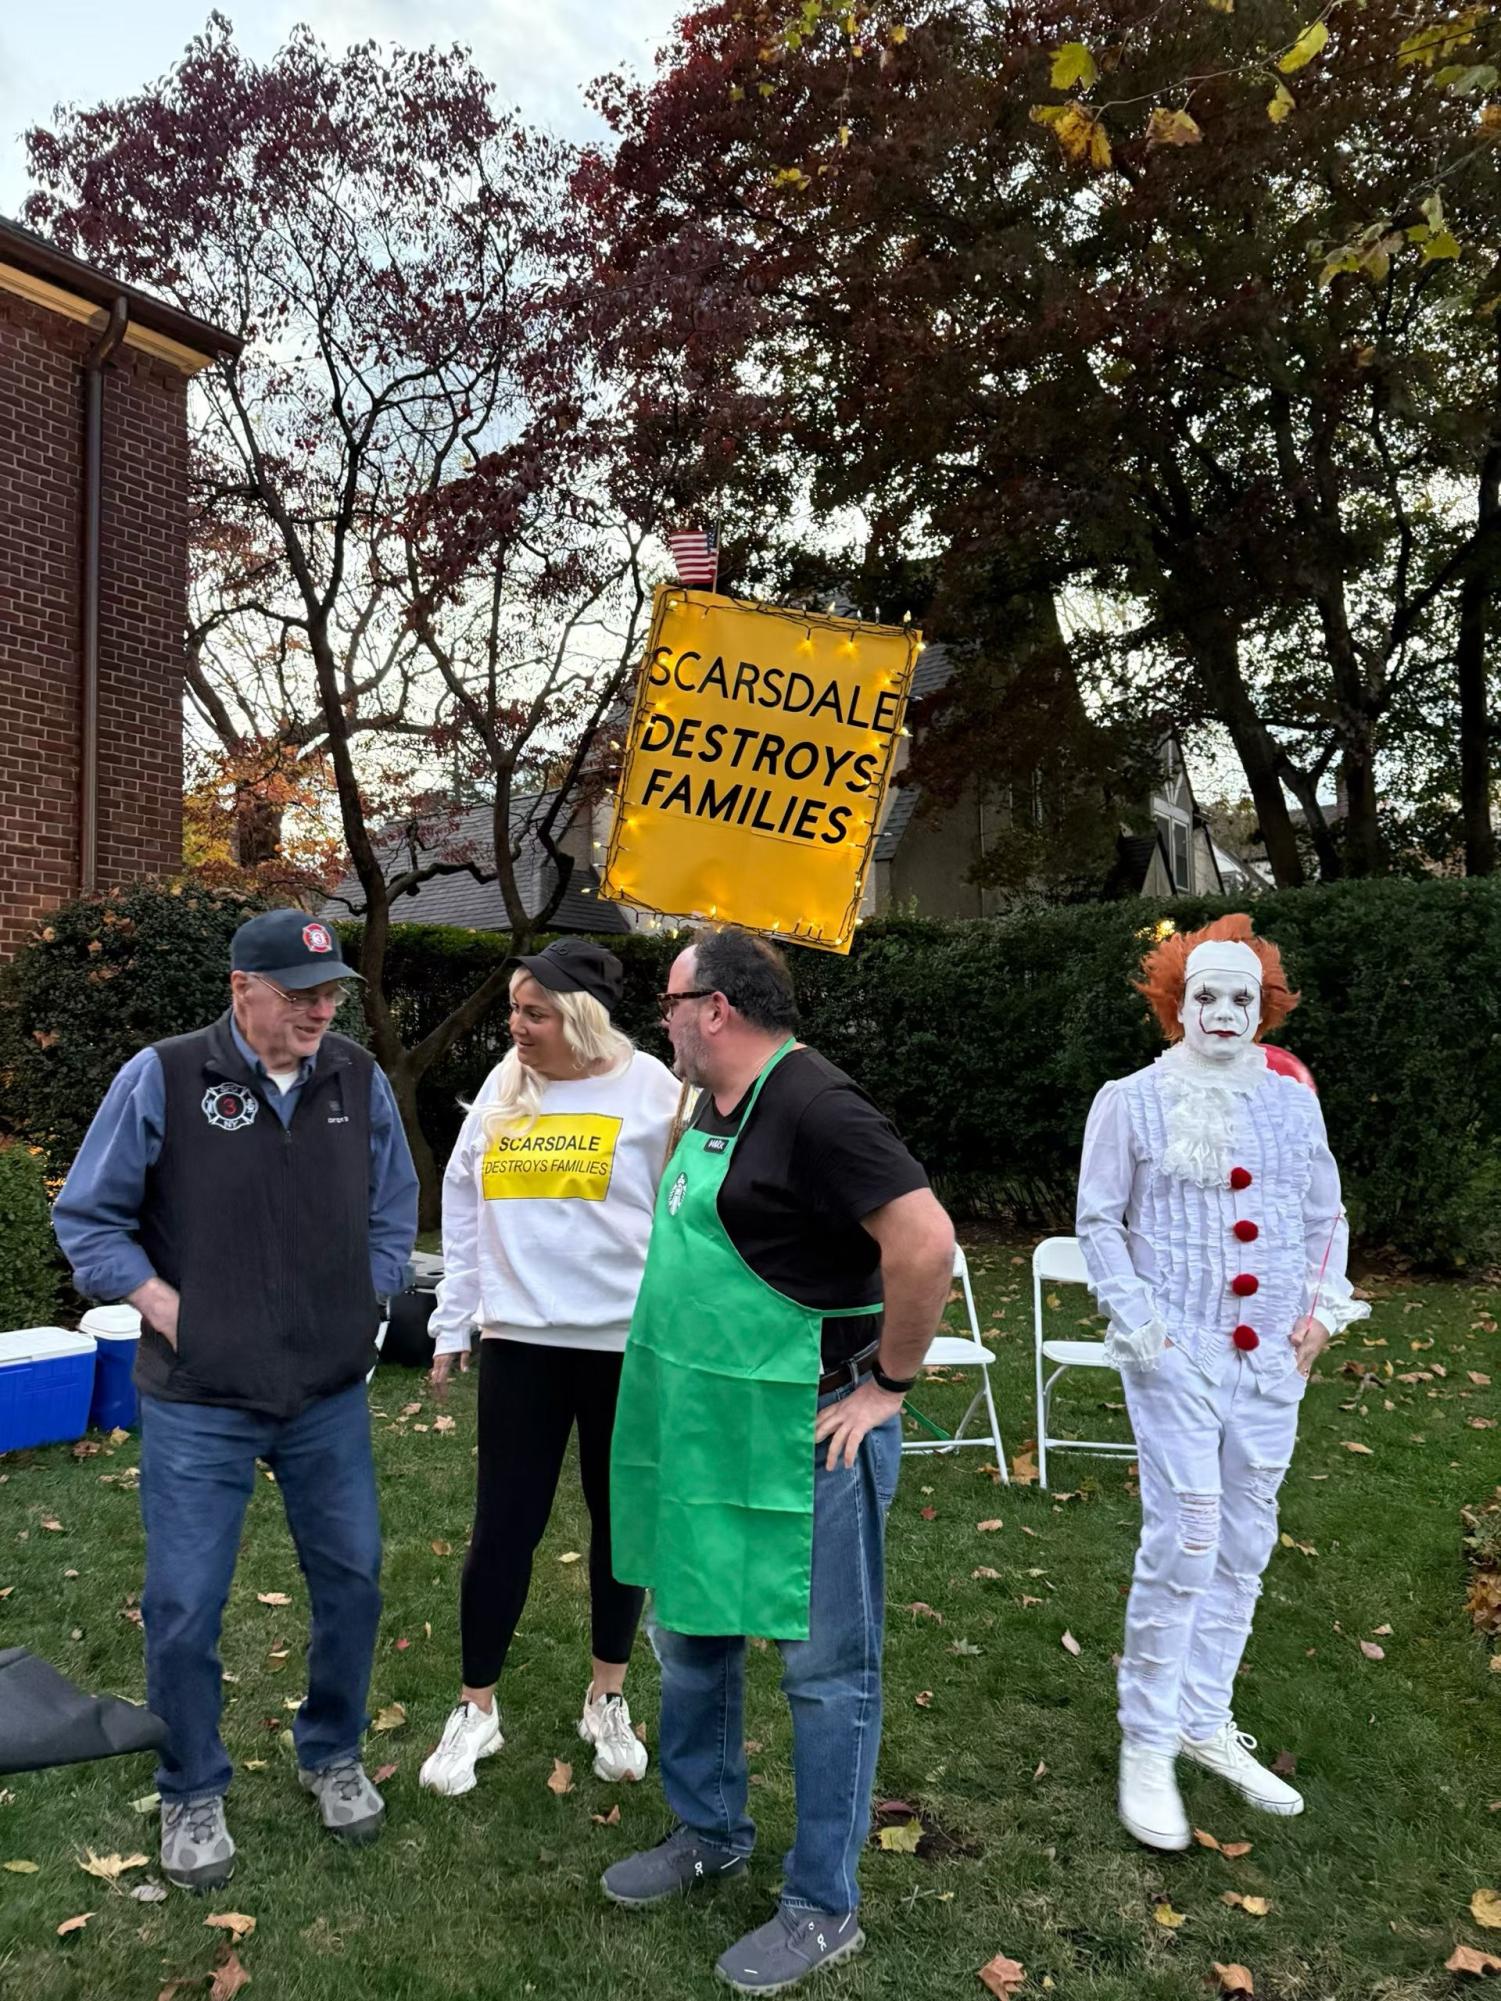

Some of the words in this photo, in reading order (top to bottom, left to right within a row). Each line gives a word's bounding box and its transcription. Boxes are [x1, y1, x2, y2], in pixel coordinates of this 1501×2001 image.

[648, 645, 901, 734] SCARSDALE
[640, 714, 878, 793] DESTROYS
[641, 769, 853, 844] FAMILIES
[222, 1095, 238, 1116] 3
[485, 1159, 548, 1175] DESTROYS
[551, 1159, 609, 1176] FAMILIES
[499, 1135, 601, 1152] SCARSDALE
